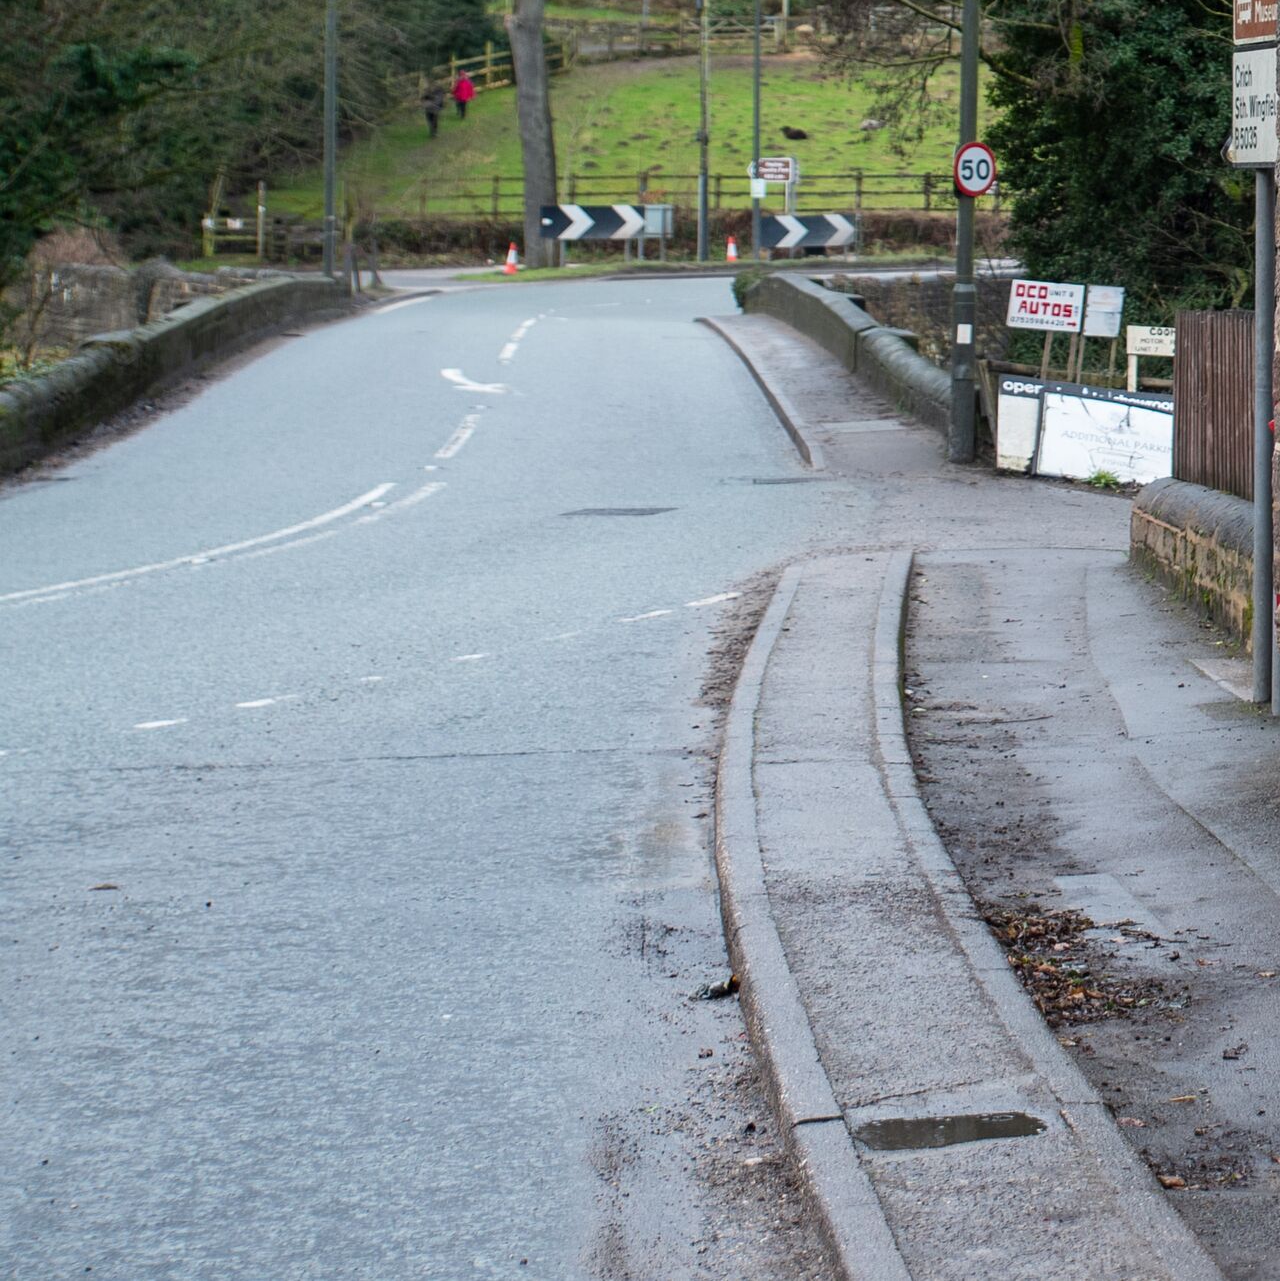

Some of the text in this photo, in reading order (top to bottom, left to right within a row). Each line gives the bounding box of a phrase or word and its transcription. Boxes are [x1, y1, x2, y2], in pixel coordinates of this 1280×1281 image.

[1254, 0, 1279, 23] Museu
[1234, 62, 1253, 88] Crich
[1249, 92, 1277, 122] Wingfiel
[961, 158, 991, 181] 50
[1017, 300, 1074, 318] AUTOS
[1061, 429, 1131, 448] ADDITIONAL
